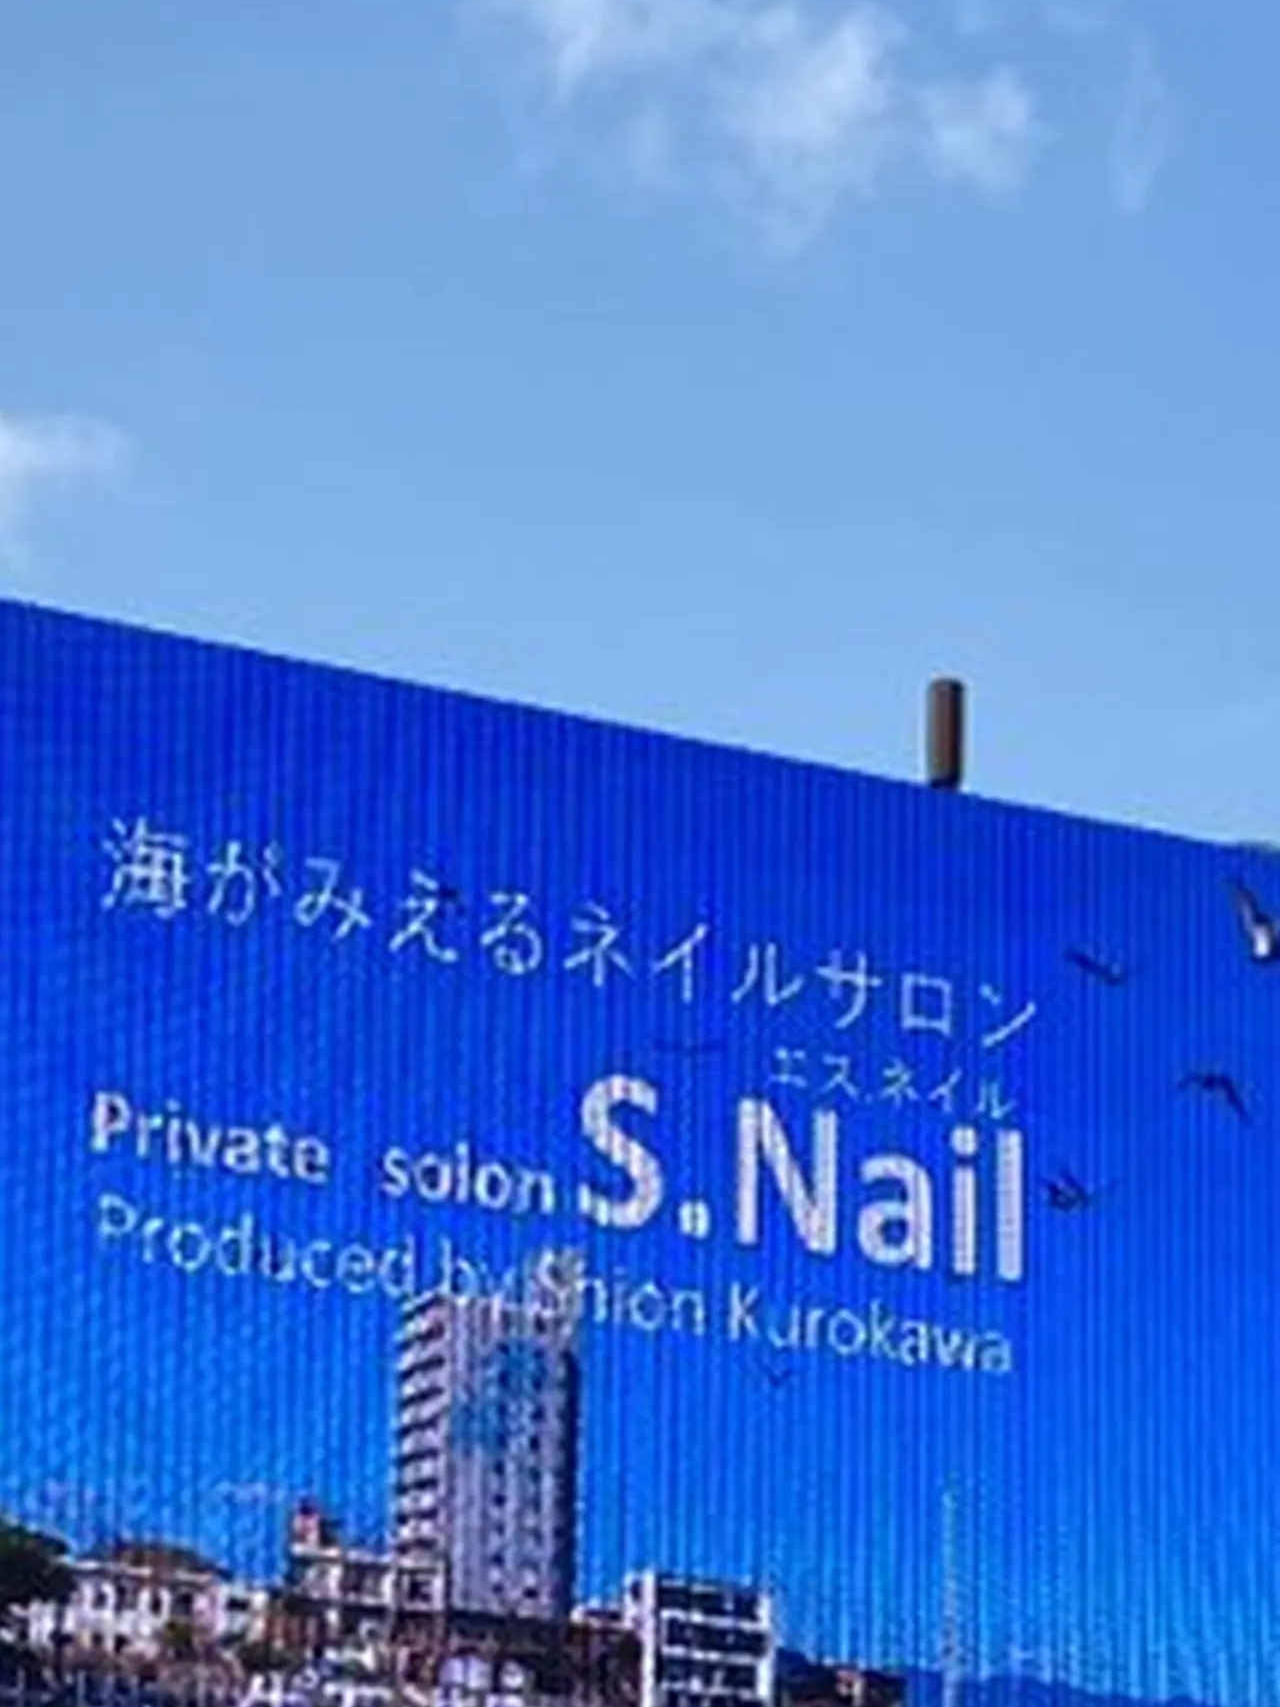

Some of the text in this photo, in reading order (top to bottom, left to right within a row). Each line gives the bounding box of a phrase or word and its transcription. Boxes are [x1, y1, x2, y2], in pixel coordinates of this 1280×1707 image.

[98, 815, 1037, 1049] 海がみえるネイルサロン
[91, 1091, 330, 1184] Private
[577, 1073, 1023, 1282] S.Nail
[96, 1192, 415, 1296] Produced
[726, 1282, 1014, 1376] Kurokawa
